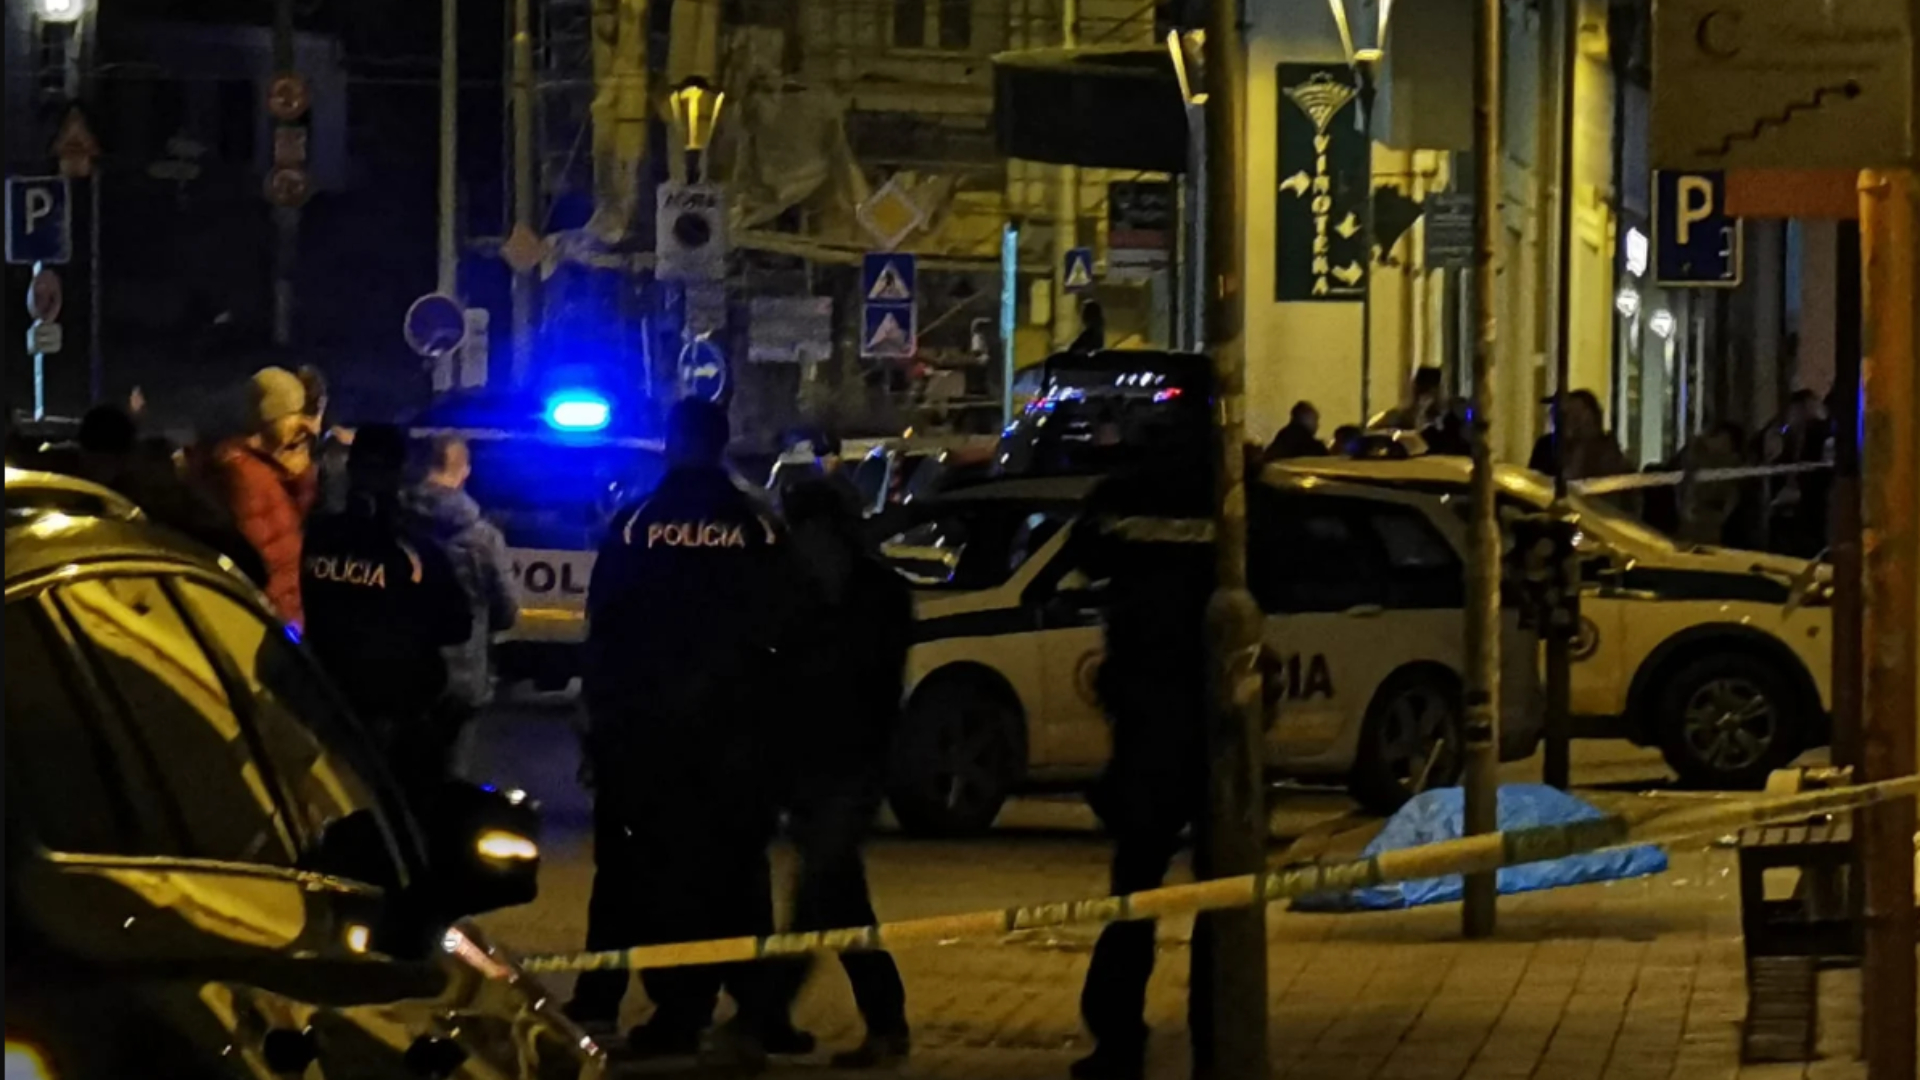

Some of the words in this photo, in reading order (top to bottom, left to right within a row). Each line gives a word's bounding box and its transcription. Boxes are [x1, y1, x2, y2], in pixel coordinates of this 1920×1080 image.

[25, 188, 53, 235] P
[1675, 174, 1714, 245] P
[513, 560, 584, 594] OL
